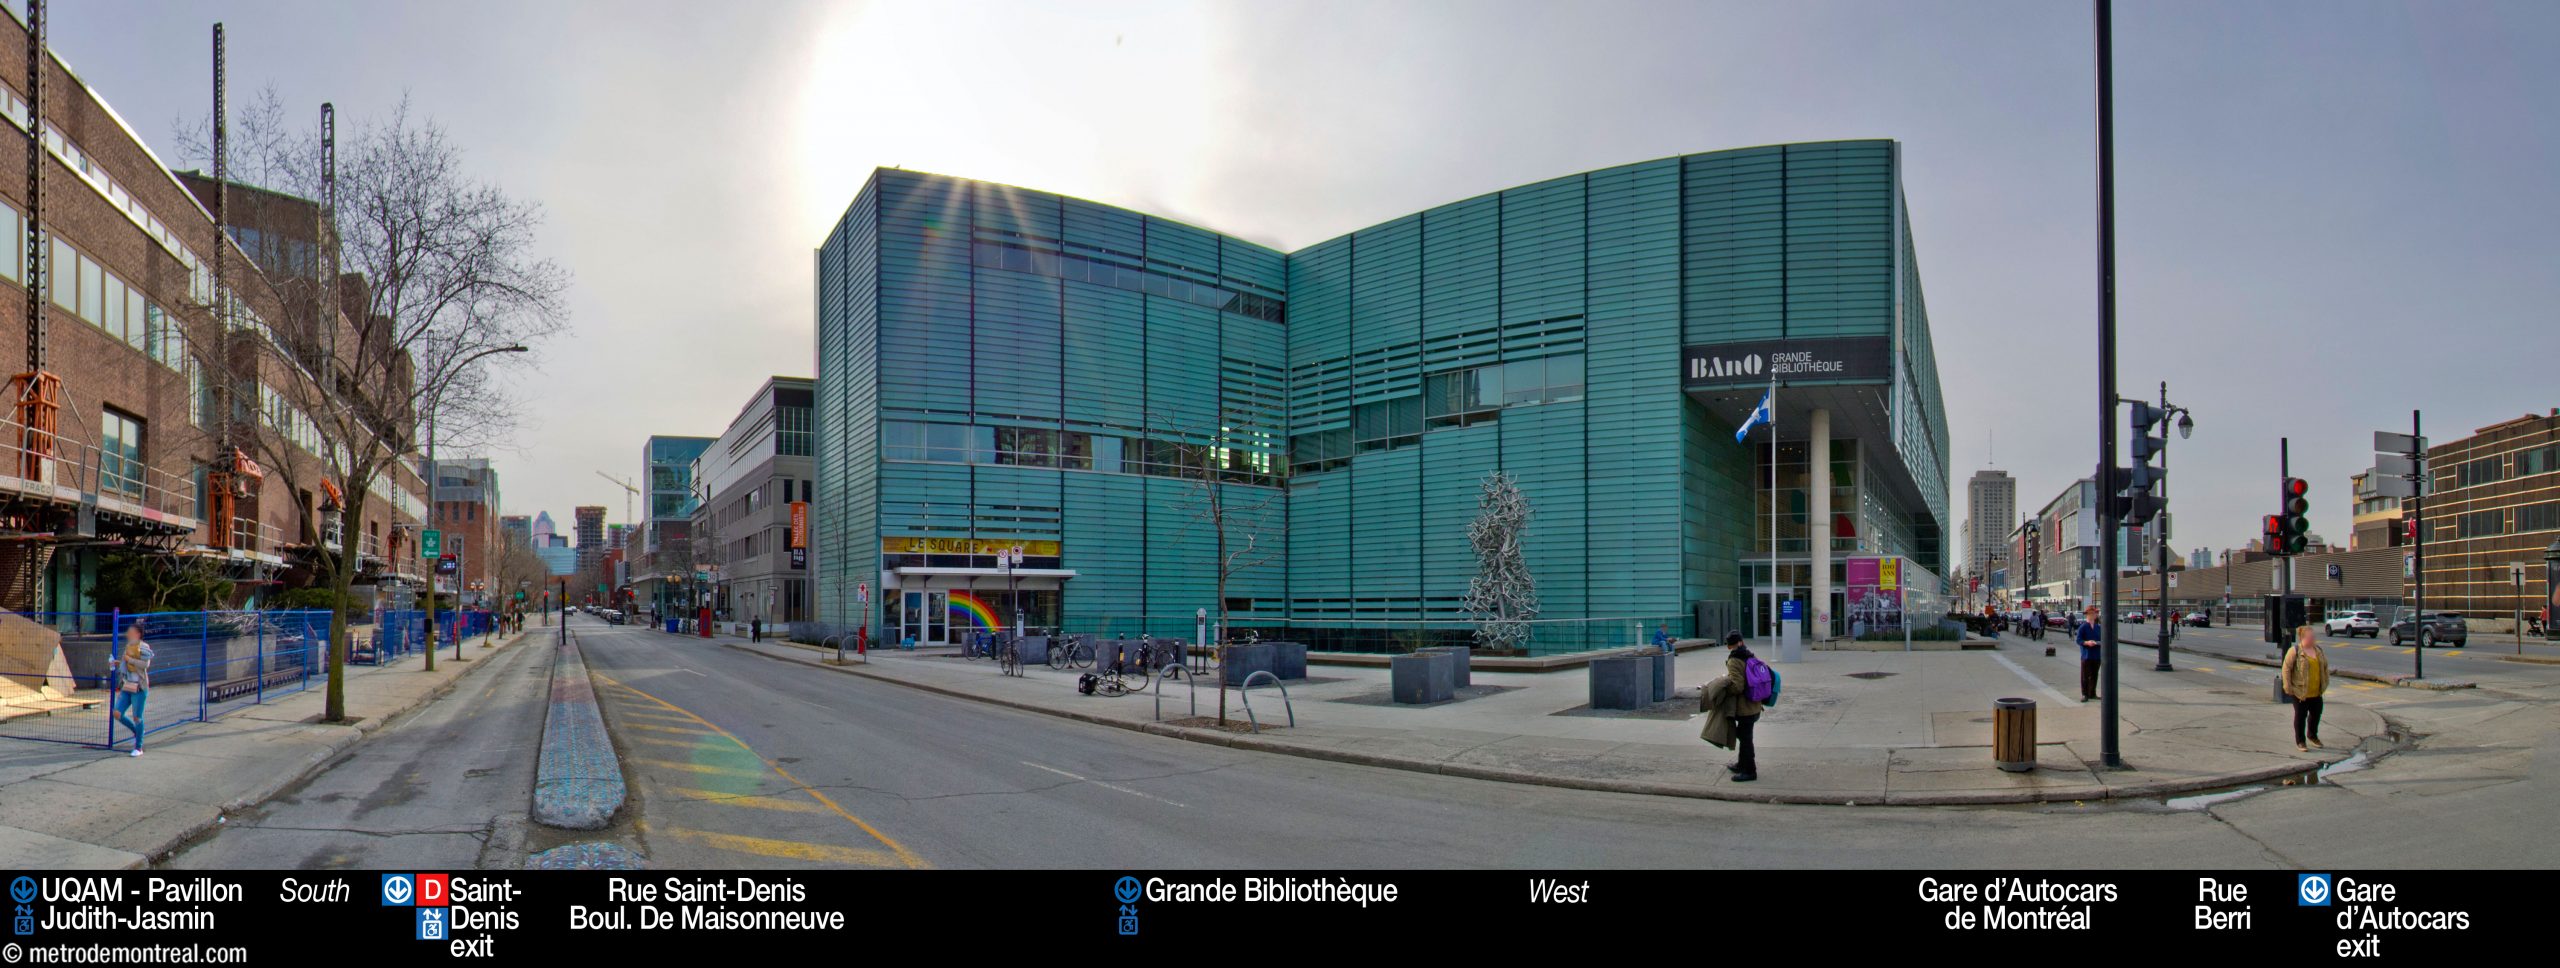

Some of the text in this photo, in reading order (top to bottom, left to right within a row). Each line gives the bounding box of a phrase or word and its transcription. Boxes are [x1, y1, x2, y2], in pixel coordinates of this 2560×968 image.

[1771, 351, 1813, 363] GRANDE
[1691, 353, 1763, 379] BAnQ
[1772, 359, 1844, 374] BIBLIOTHÈQUE
[24, 481, 52, 494] FRACO
[909, 537, 979, 554] LE SQUARE
